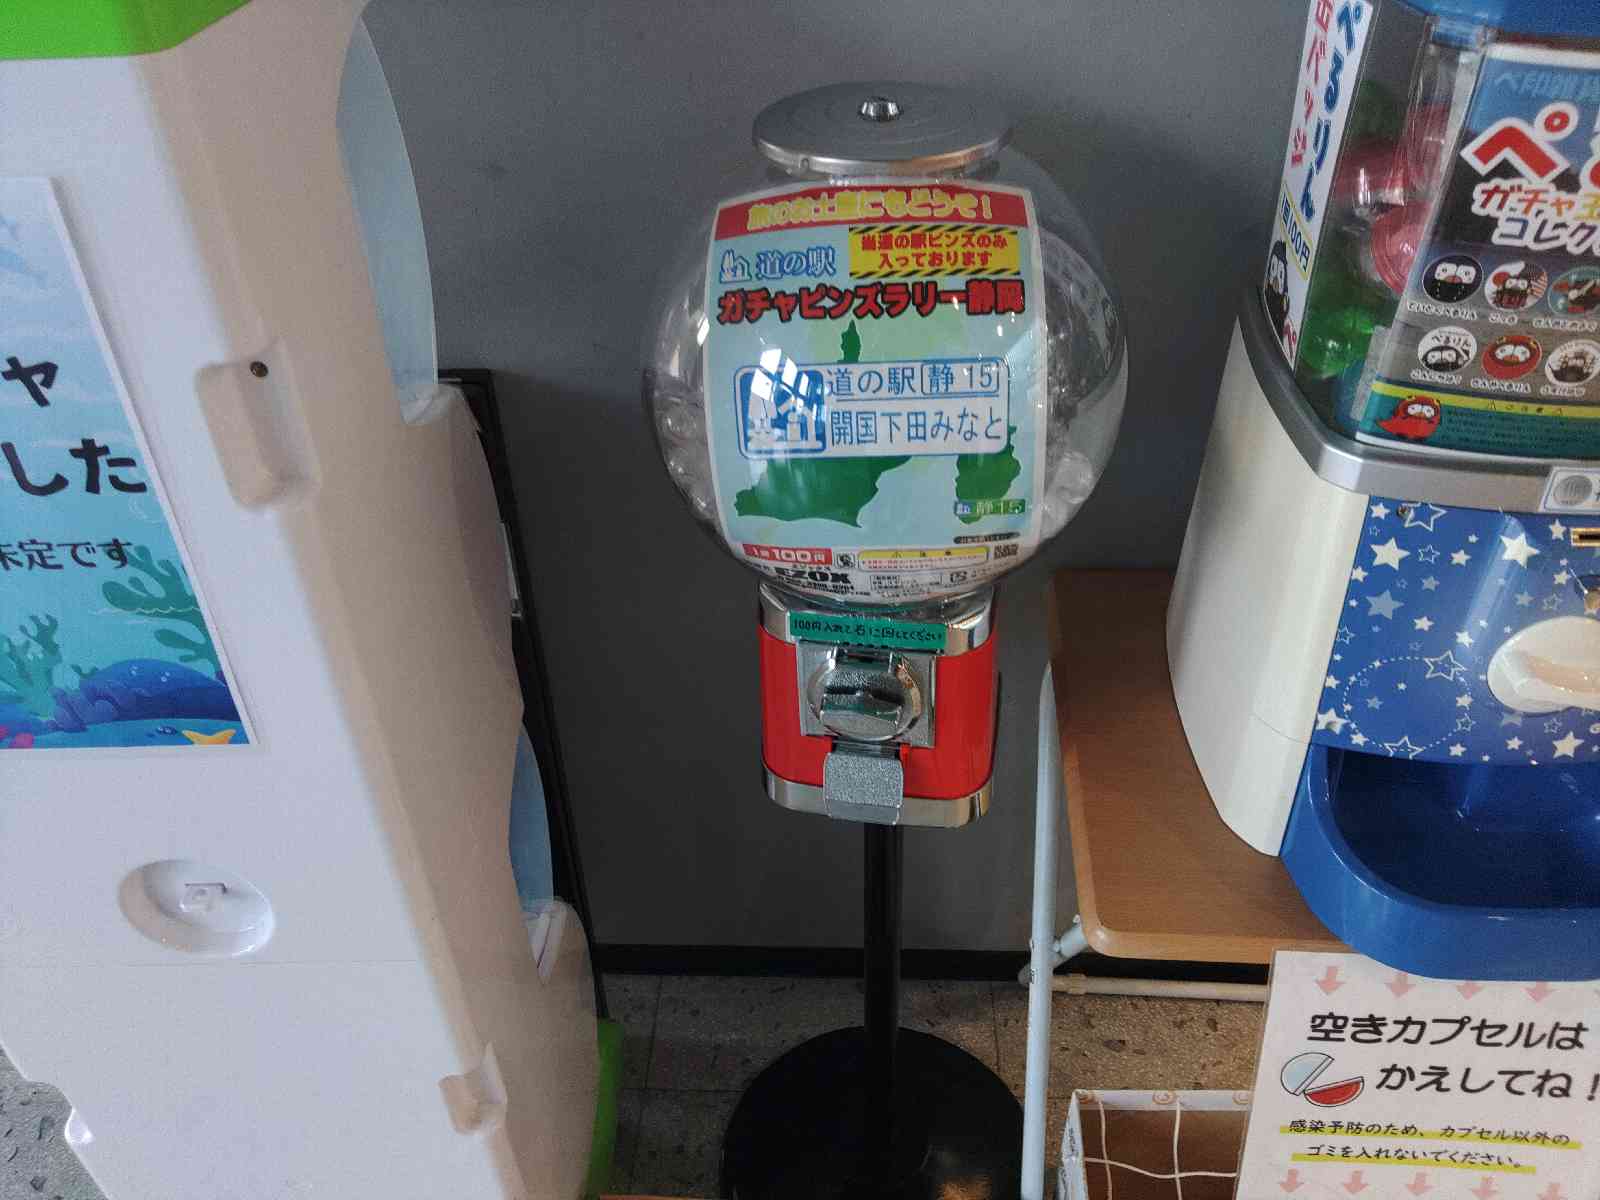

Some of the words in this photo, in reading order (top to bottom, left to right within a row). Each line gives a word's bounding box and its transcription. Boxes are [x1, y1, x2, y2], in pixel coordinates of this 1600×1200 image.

[756, 246, 837, 281] 道の駅
[878, 252, 993, 270] 入っております
[826, 367, 916, 397] 道の駅
[927, 367, 954, 393] 静
[967, 365, 993, 390] 15
[829, 406, 1003, 447] 開国下田みなと
[1307, 1011, 1590, 1051] 空きカプセルは
[1375, 1062, 1600, 1101] かえしてね！
[1307, 1143, 1522, 1170] ゴミを入れないでください。
